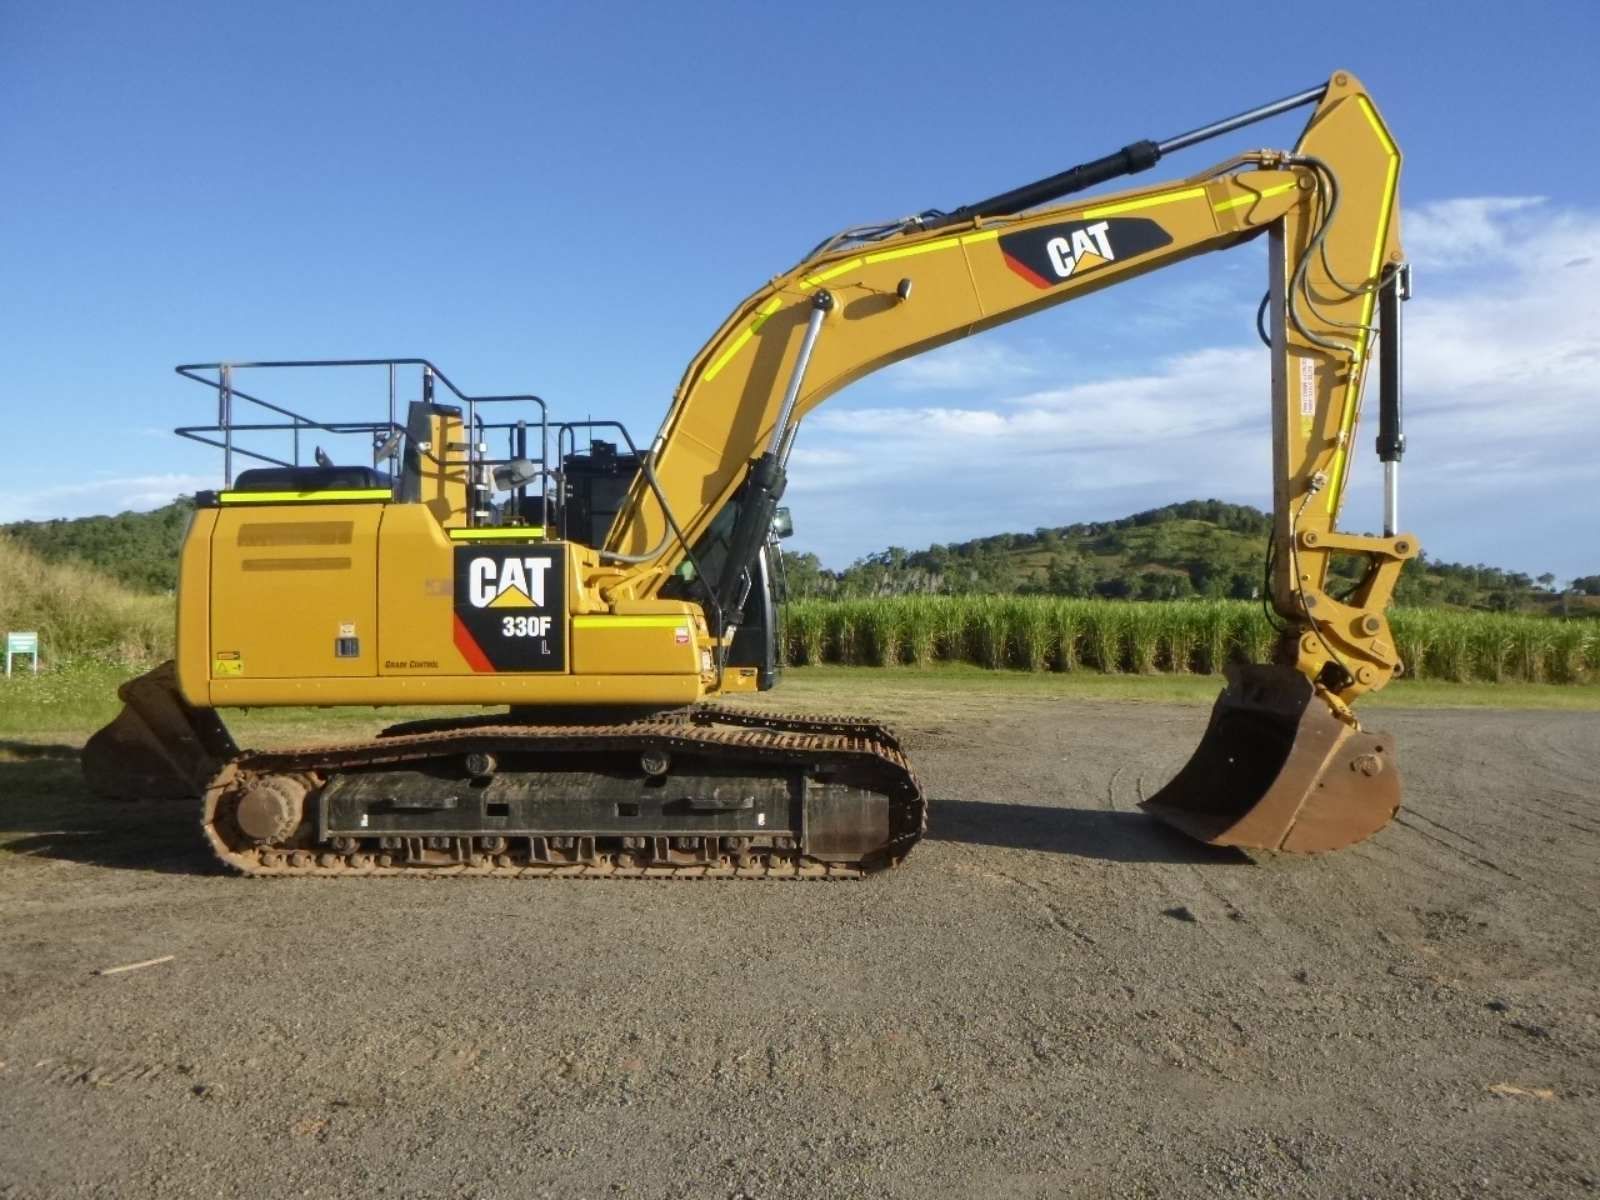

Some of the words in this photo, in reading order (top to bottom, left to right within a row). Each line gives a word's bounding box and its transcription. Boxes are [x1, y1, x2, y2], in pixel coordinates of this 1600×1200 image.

[1046, 221, 1115, 277] CAT
[469, 557, 552, 608] CAT
[502, 616, 551, 637] 330F
[541, 639, 551, 654] L
